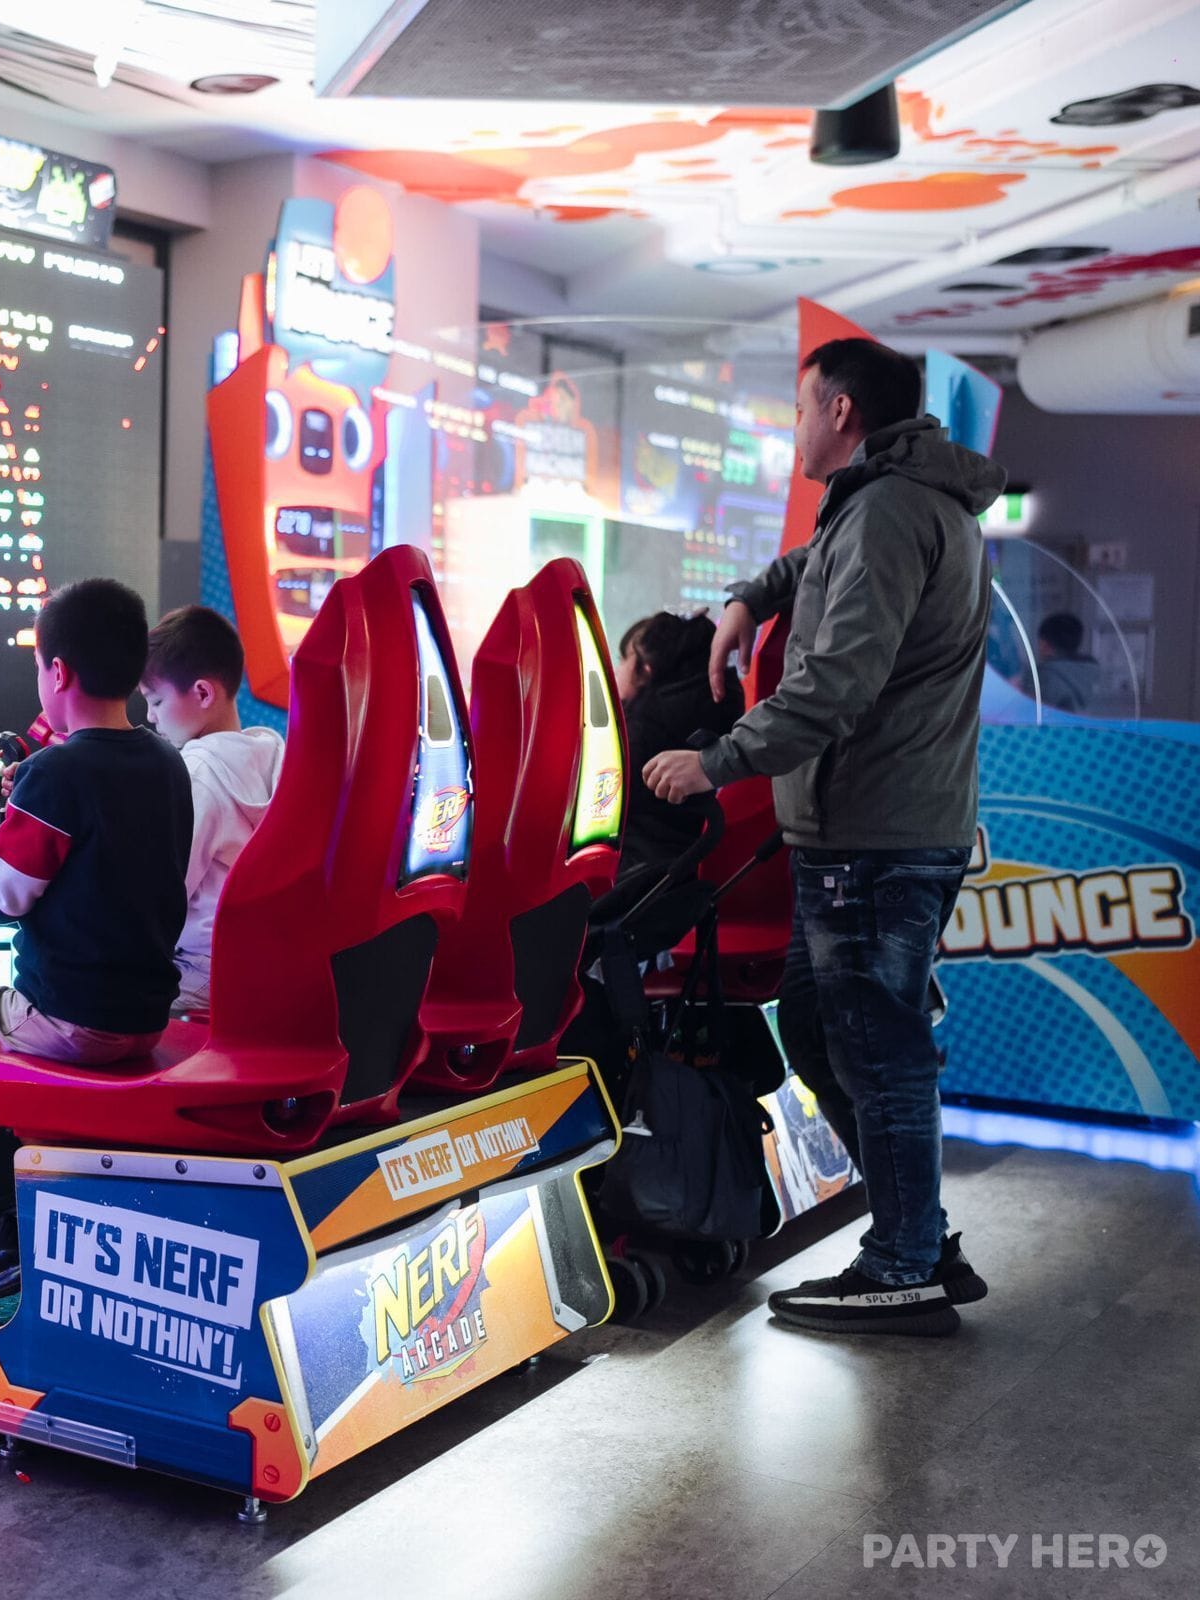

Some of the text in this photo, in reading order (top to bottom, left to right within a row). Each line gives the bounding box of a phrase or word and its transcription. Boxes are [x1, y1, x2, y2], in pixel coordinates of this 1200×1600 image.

[939, 867, 1187, 954] OUNCE
[385, 1116, 537, 1192] IT'S NERF OR NOTHIN'!
[46, 1208, 244, 1308] IT'S NERF
[371, 1204, 481, 1366] NERF
[864, 1292, 921, 1304] SPLY-350
[39, 1278, 236, 1377] OR NOTHIN'!
[401, 1309, 487, 1379] ARCADE
